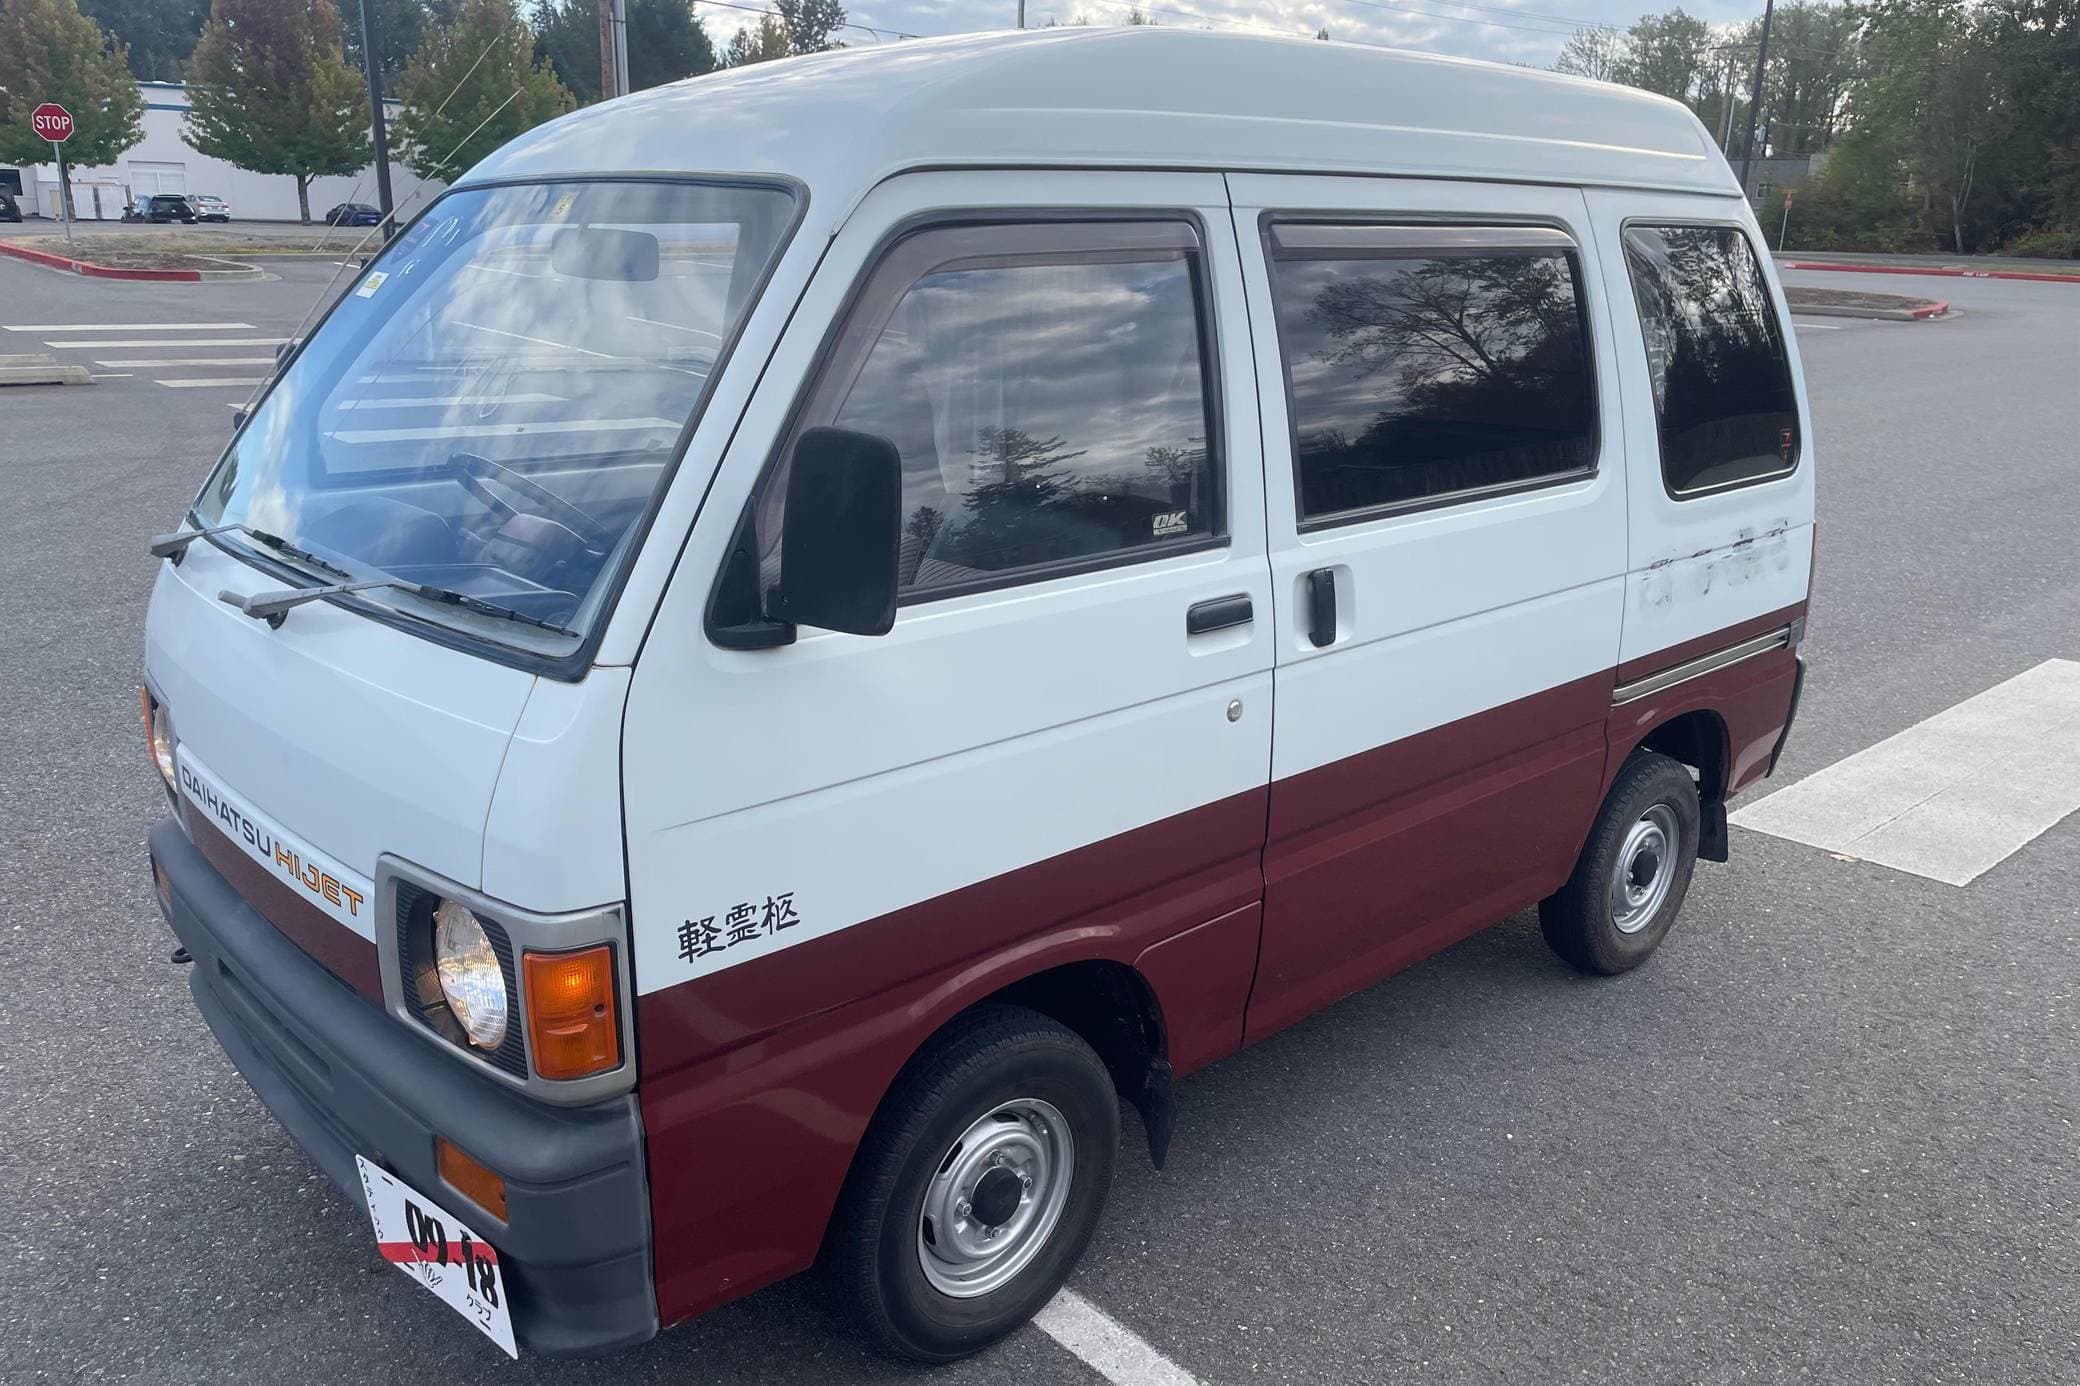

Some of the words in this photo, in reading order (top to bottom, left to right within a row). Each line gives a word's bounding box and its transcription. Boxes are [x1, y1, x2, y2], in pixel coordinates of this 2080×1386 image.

[36, 115, 70, 130] STOP
[181, 765, 271, 857] DAIHATSU
[274, 841, 364, 917] HIJET
[677, 892, 801, 963] 軽霊柩
